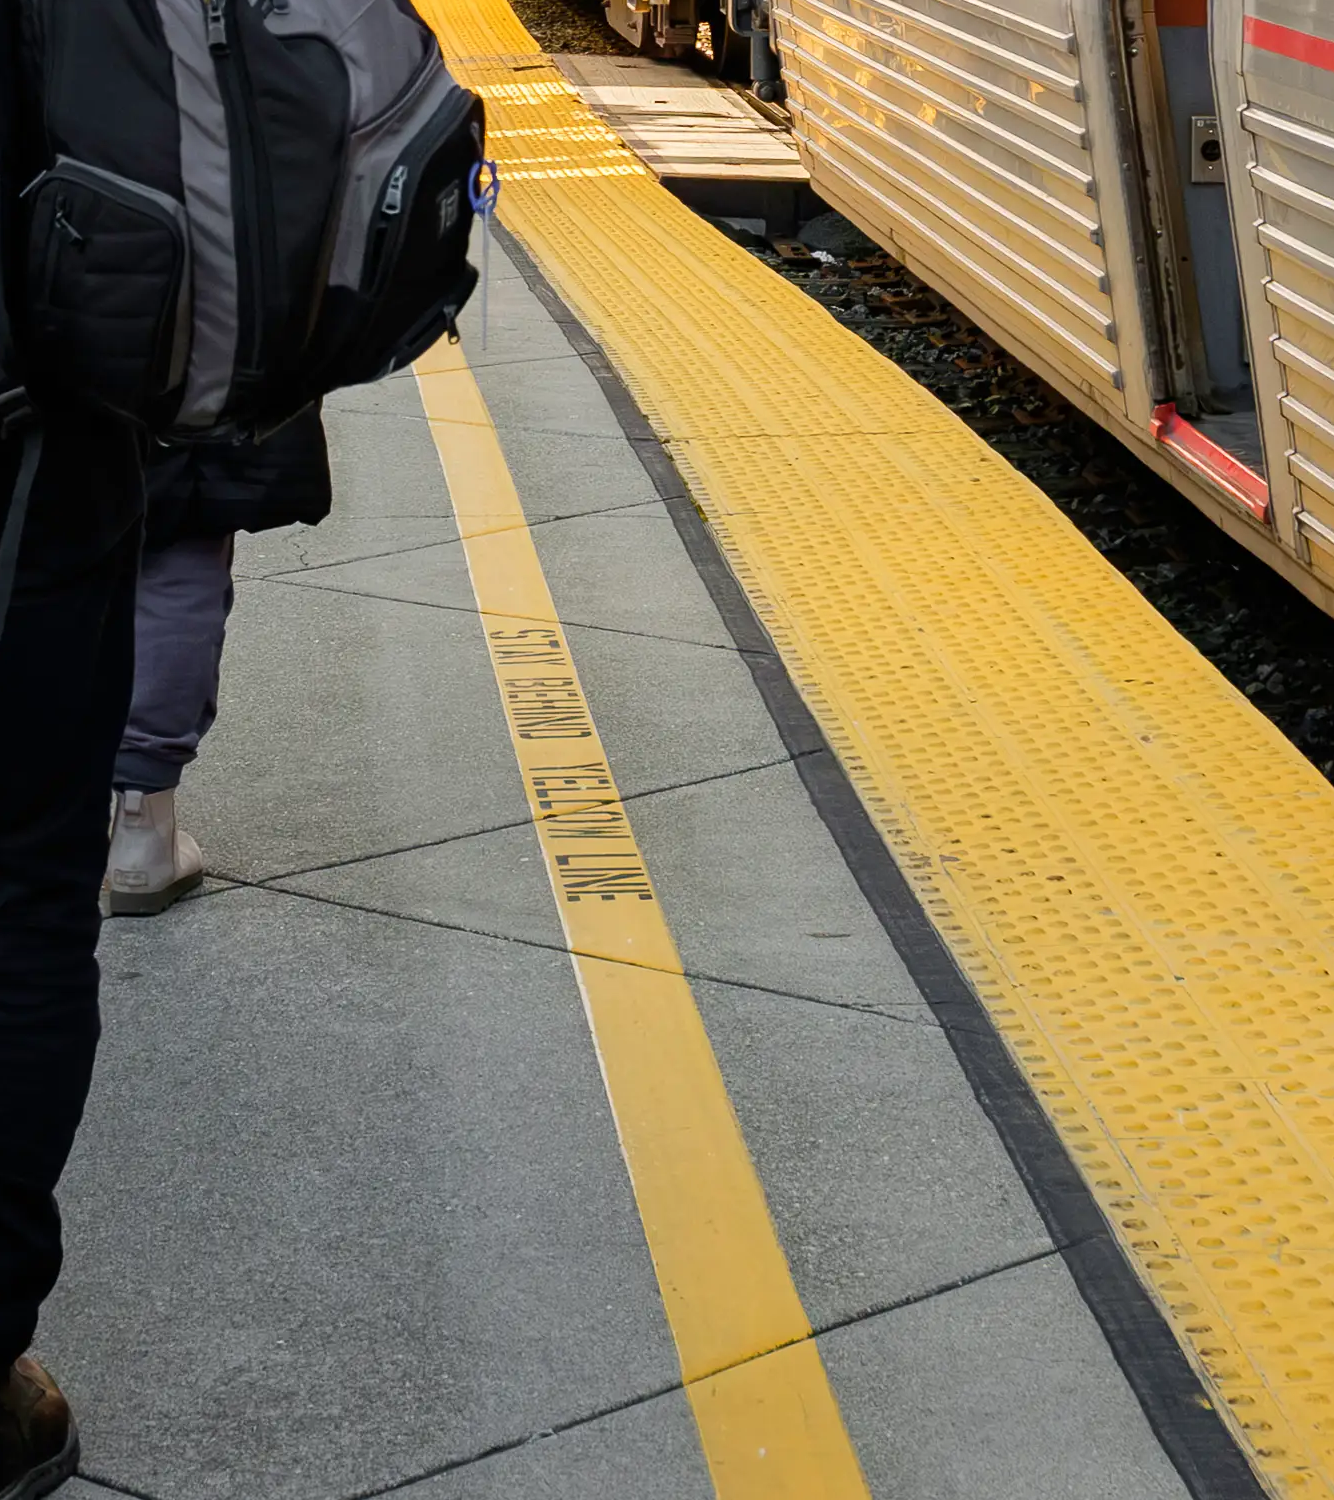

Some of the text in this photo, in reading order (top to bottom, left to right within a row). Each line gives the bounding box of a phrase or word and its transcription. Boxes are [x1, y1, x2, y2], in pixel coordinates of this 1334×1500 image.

[489, 629, 653, 902] STAY BEHIND YELLOW LINE
